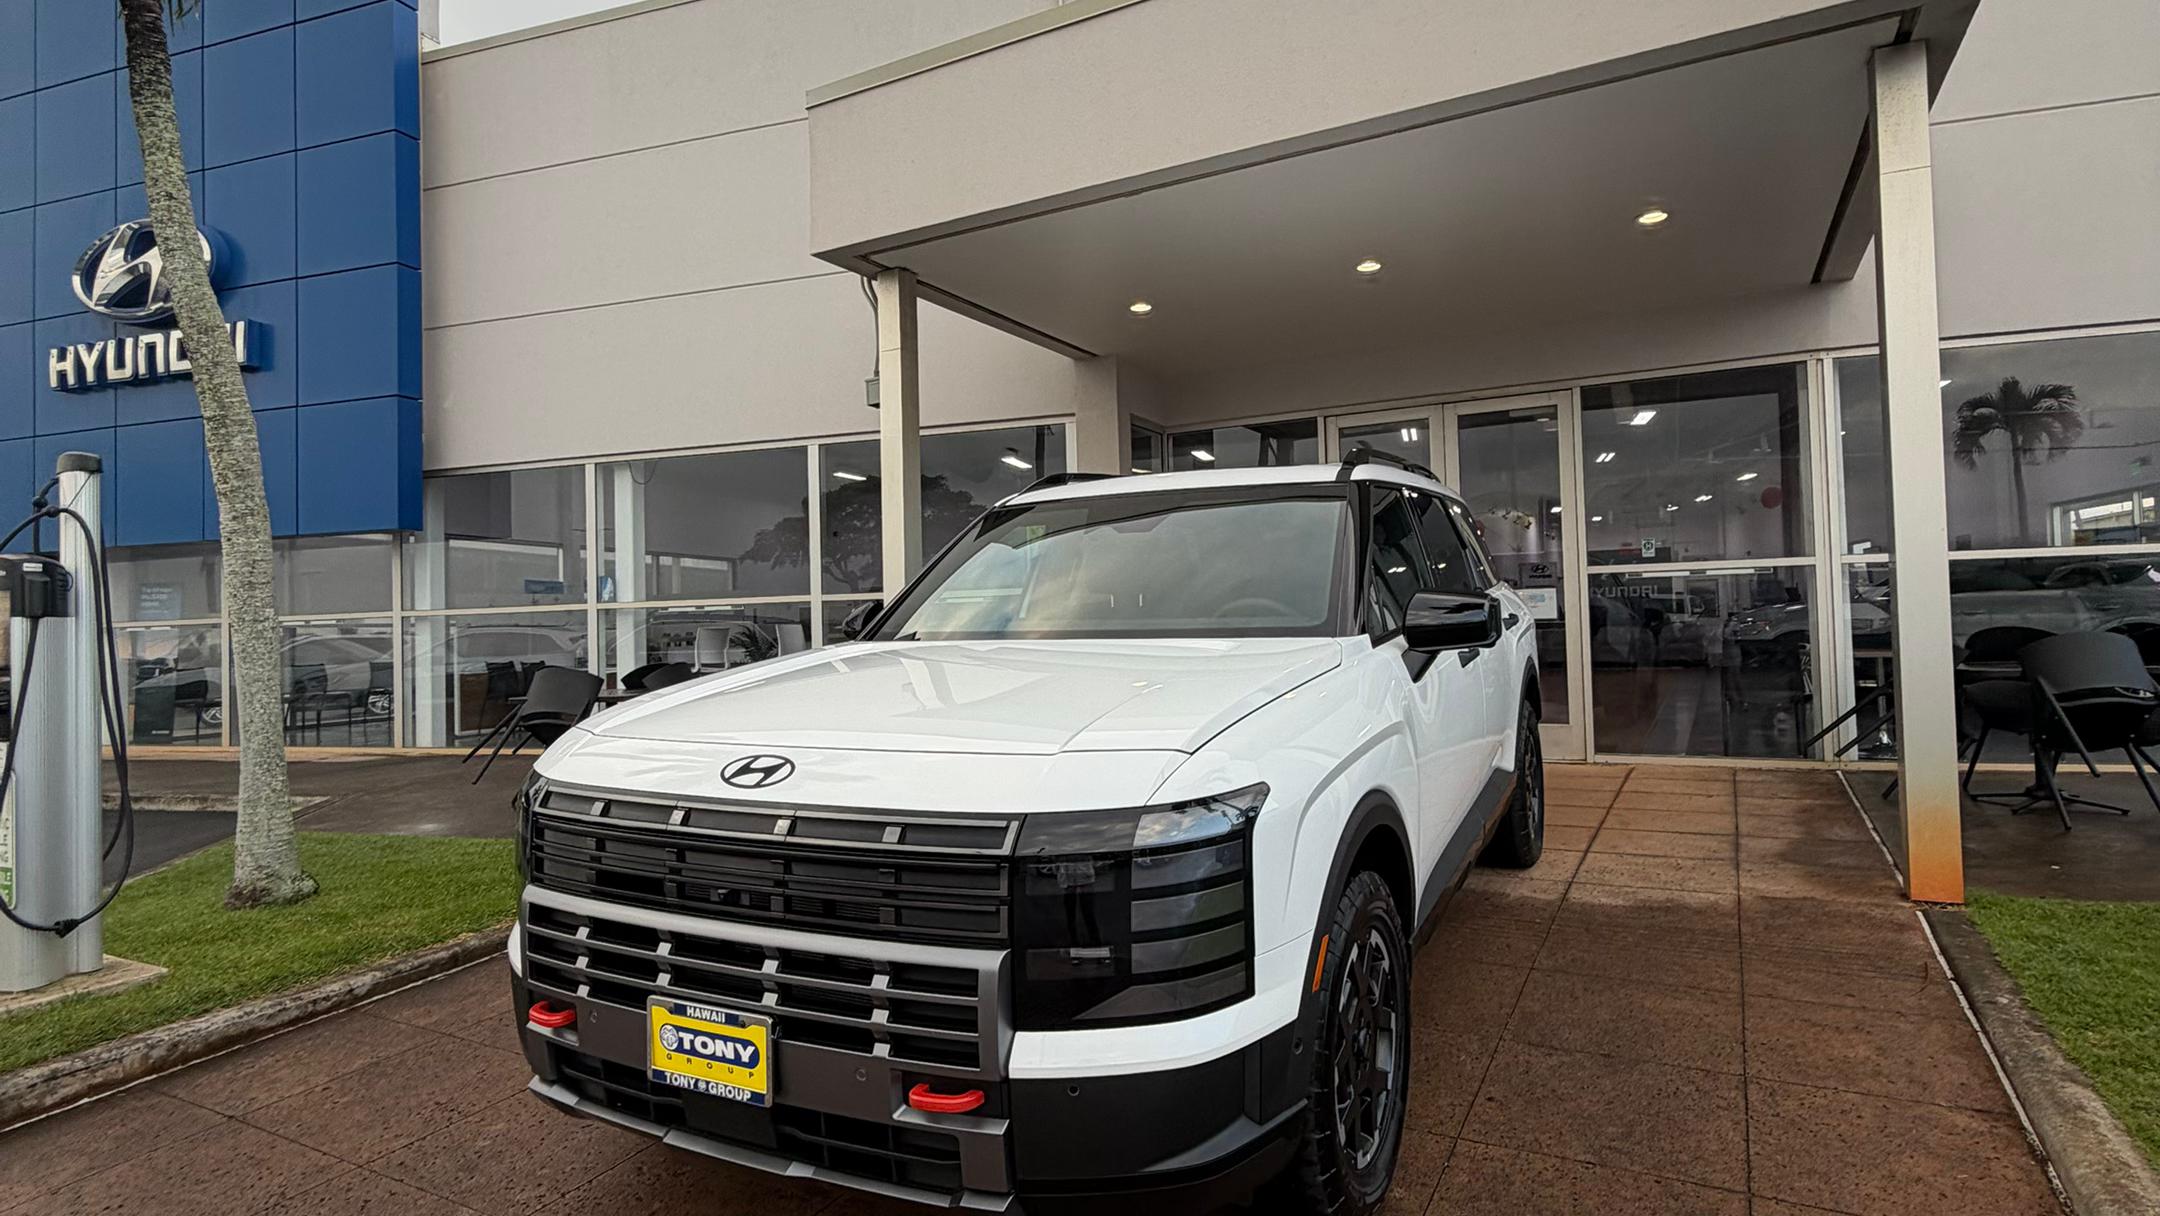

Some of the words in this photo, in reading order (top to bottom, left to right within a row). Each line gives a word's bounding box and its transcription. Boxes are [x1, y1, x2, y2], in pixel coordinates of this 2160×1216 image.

[686, 1006, 726, 1024] HAWAII
[678, 1031, 756, 1063] TONY
[666, 1053, 754, 1079] GROUP
[664, 1072, 697, 1090] TONY
[708, 1084, 752, 1102] GROUP
